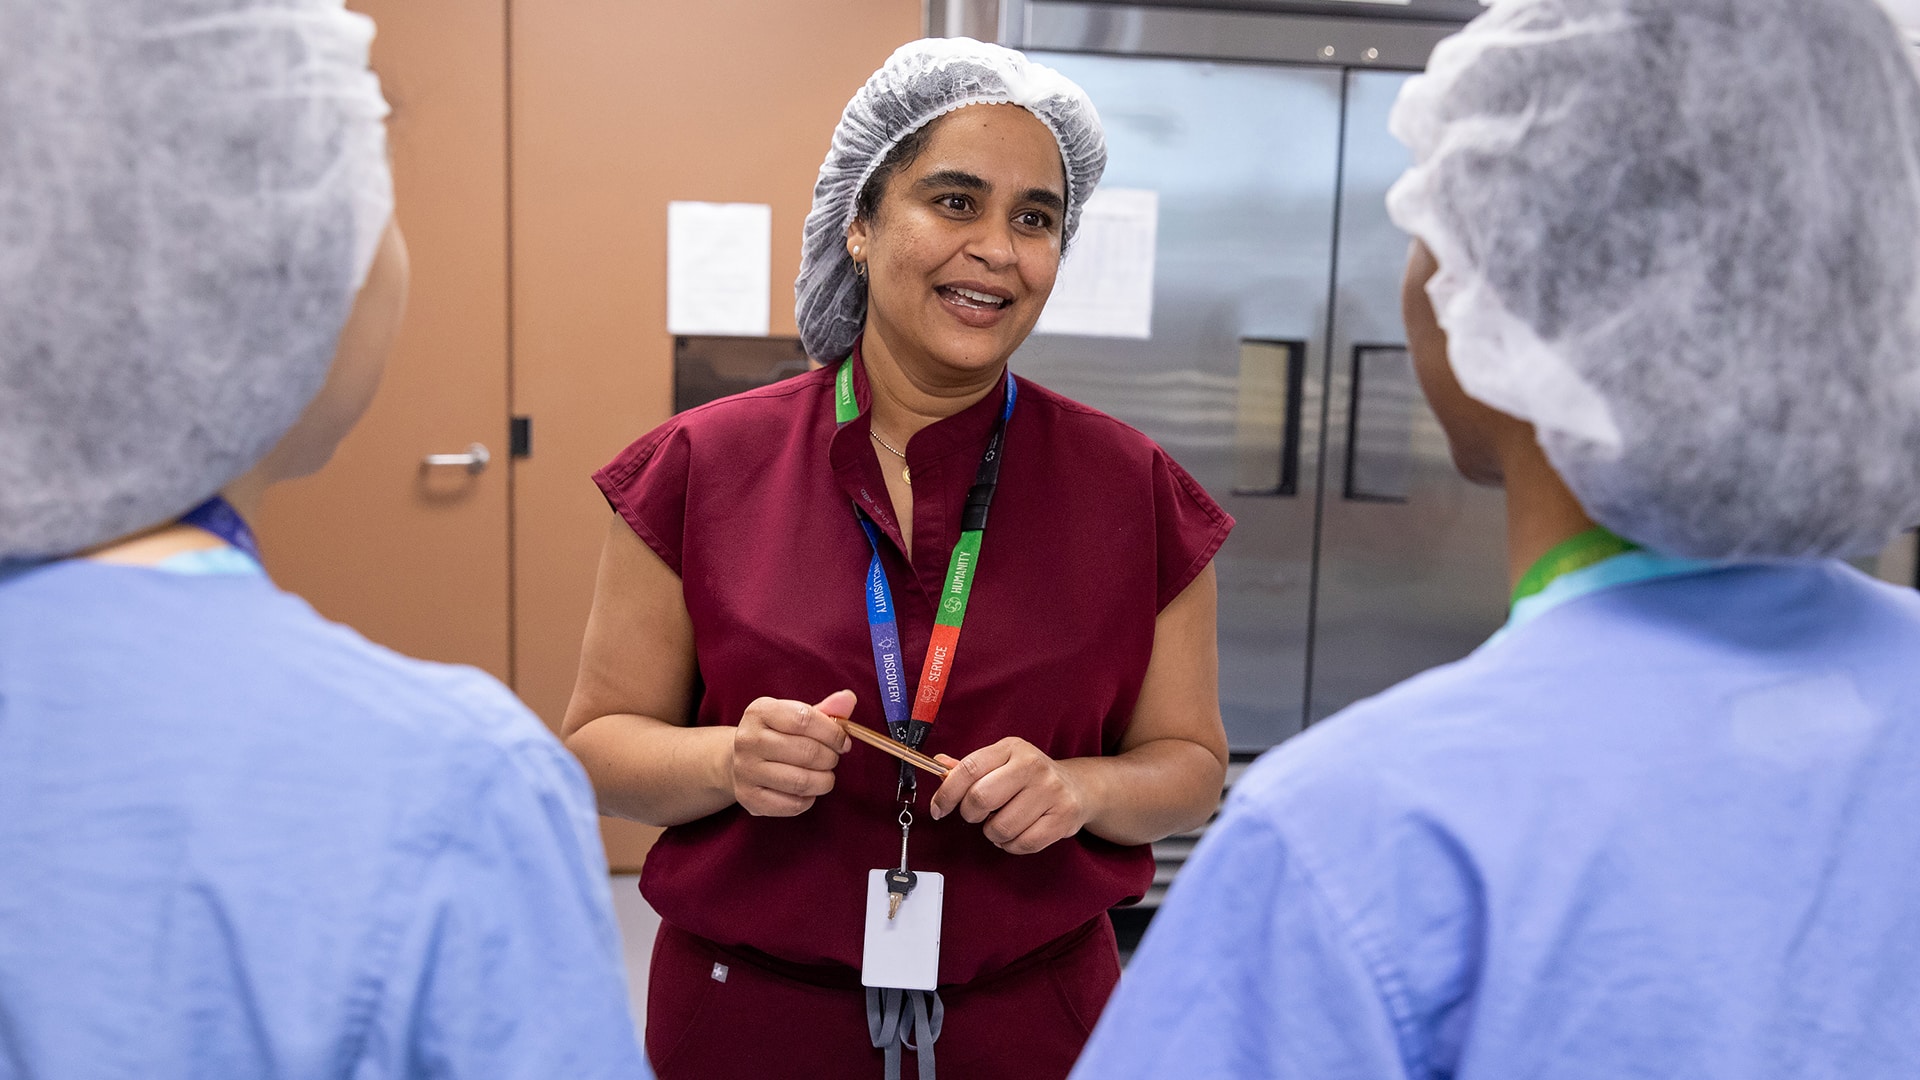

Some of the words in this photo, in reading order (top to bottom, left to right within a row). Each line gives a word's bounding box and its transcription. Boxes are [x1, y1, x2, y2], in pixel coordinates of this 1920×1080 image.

[873, 562, 888, 613] INCLUSIVITY
[951, 551, 971, 594] HUMANITY
[882, 653, 901, 703] DISCOVERY
[929, 645, 948, 682] SERVICE
